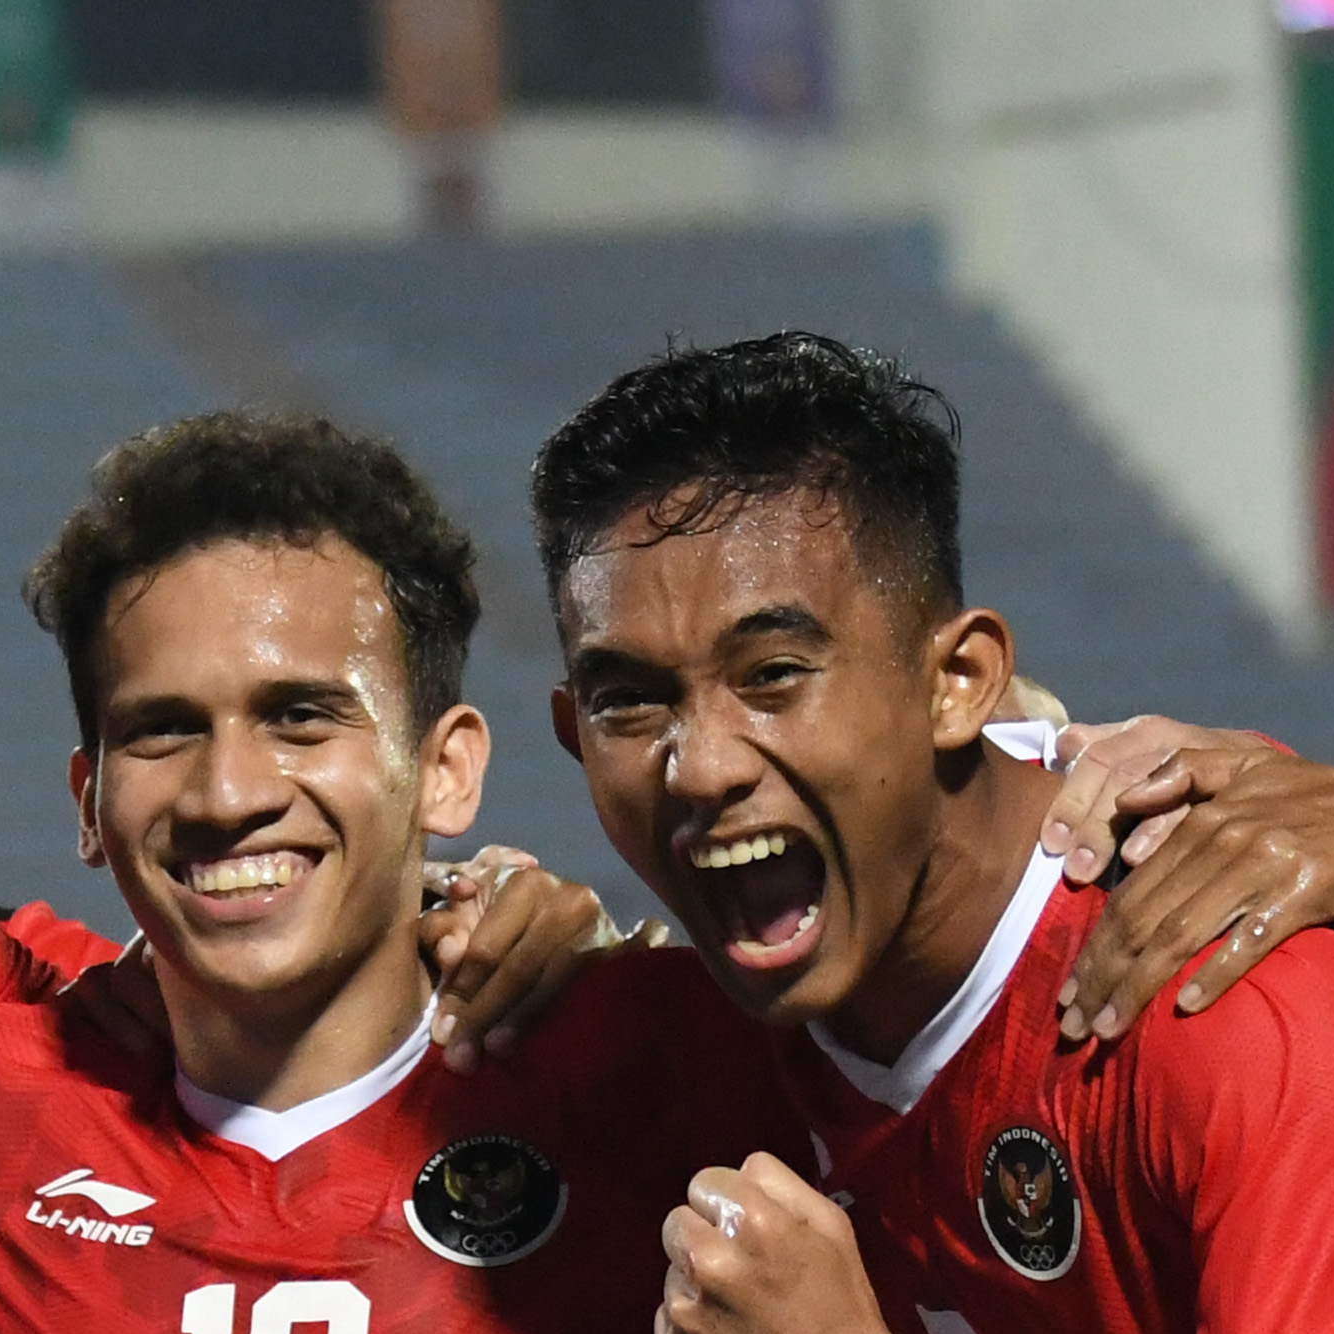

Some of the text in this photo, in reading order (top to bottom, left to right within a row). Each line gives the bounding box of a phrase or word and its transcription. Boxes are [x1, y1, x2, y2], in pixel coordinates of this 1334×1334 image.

[418, 1153, 444, 1185] TIM
[985, 1128, 1068, 1182] TIM INDONESIA
[25, 1201, 155, 1247] LI-NING
